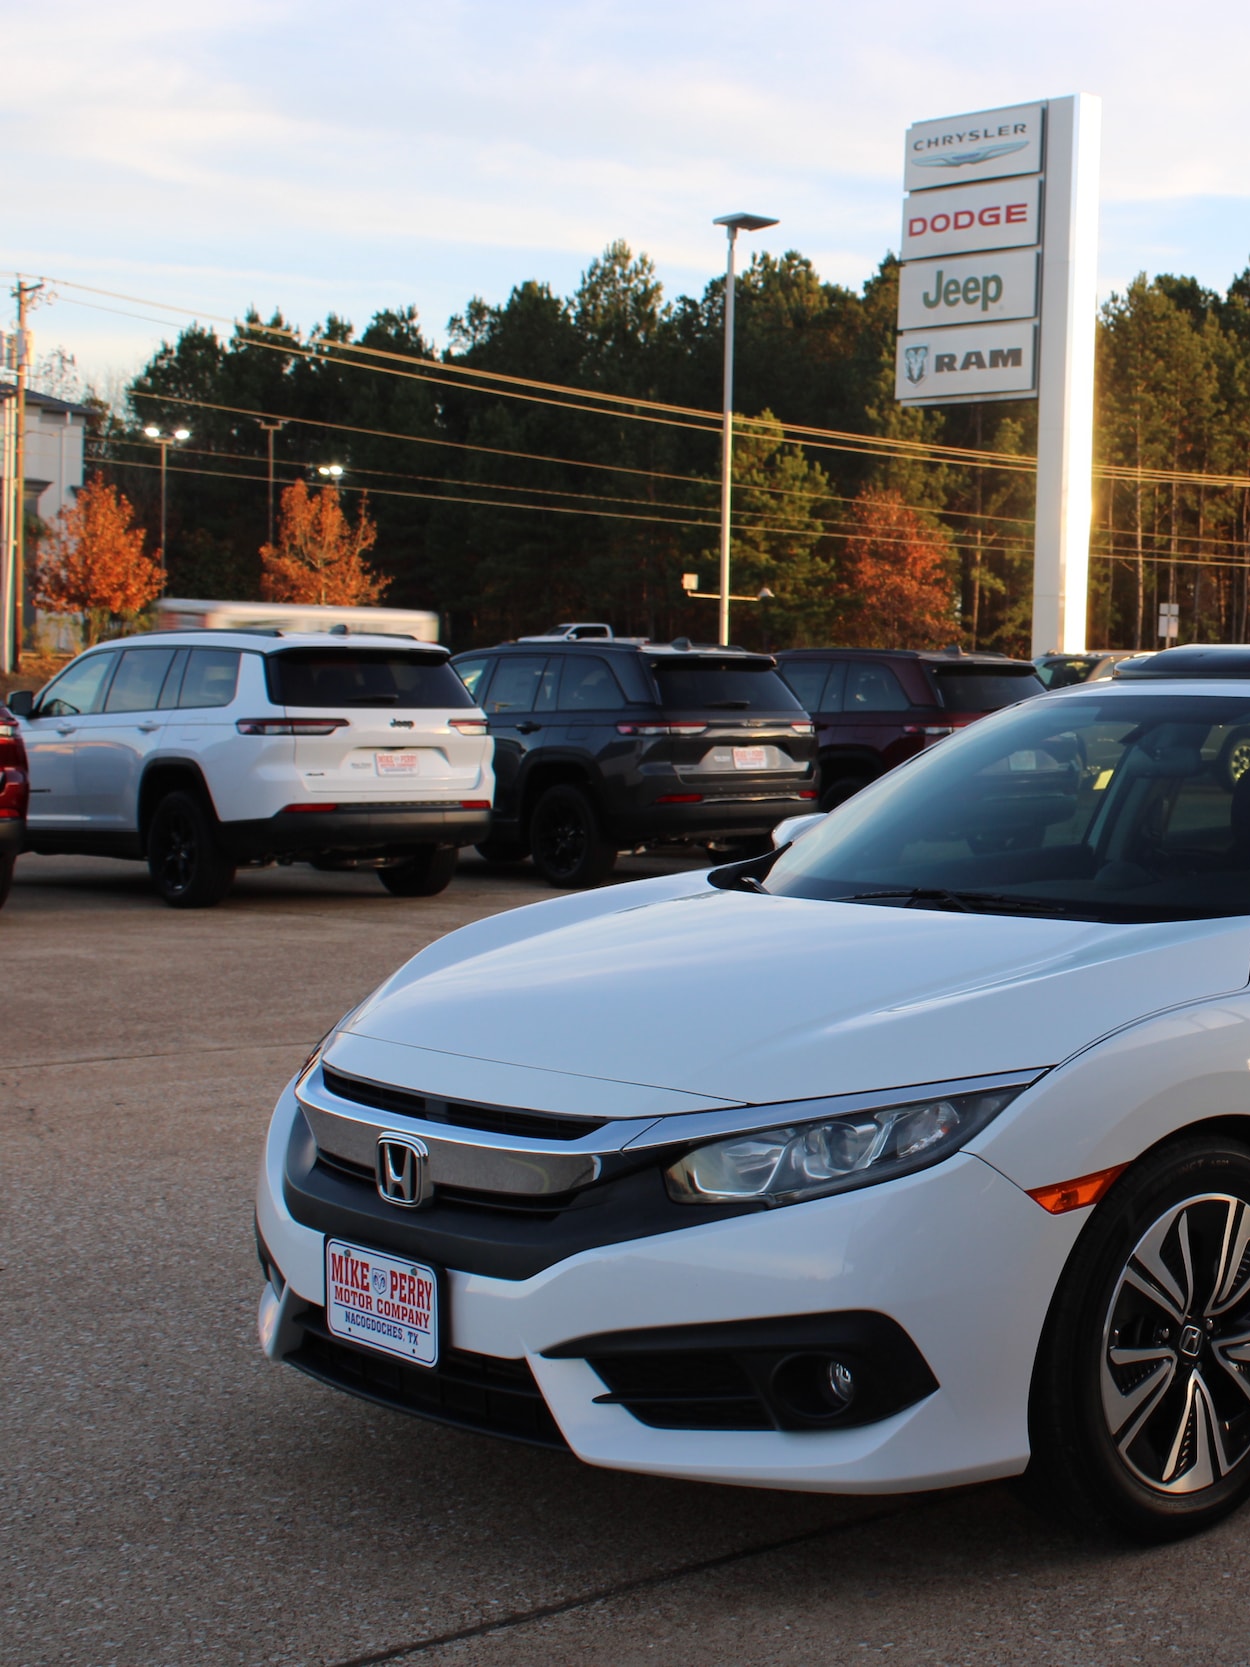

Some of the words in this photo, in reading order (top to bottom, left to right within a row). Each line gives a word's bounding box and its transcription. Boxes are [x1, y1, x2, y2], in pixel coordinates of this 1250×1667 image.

[913, 123, 1028, 151] CHRYSLER
[908, 203, 1028, 237] DODGE
[923, 270, 1003, 311] Jeep
[935, 348, 1022, 373] RAM
[390, 718, 414, 729] Jeep
[331, 1253, 370, 1292] MIKE
[390, 1270, 432, 1311] PERRY
[334, 1285, 373, 1311] MOTOR
[377, 1298, 430, 1329] COMPANY
[345, 1310, 405, 1342] NACOGDOCHES,
[407, 1331, 419, 1346] TX
